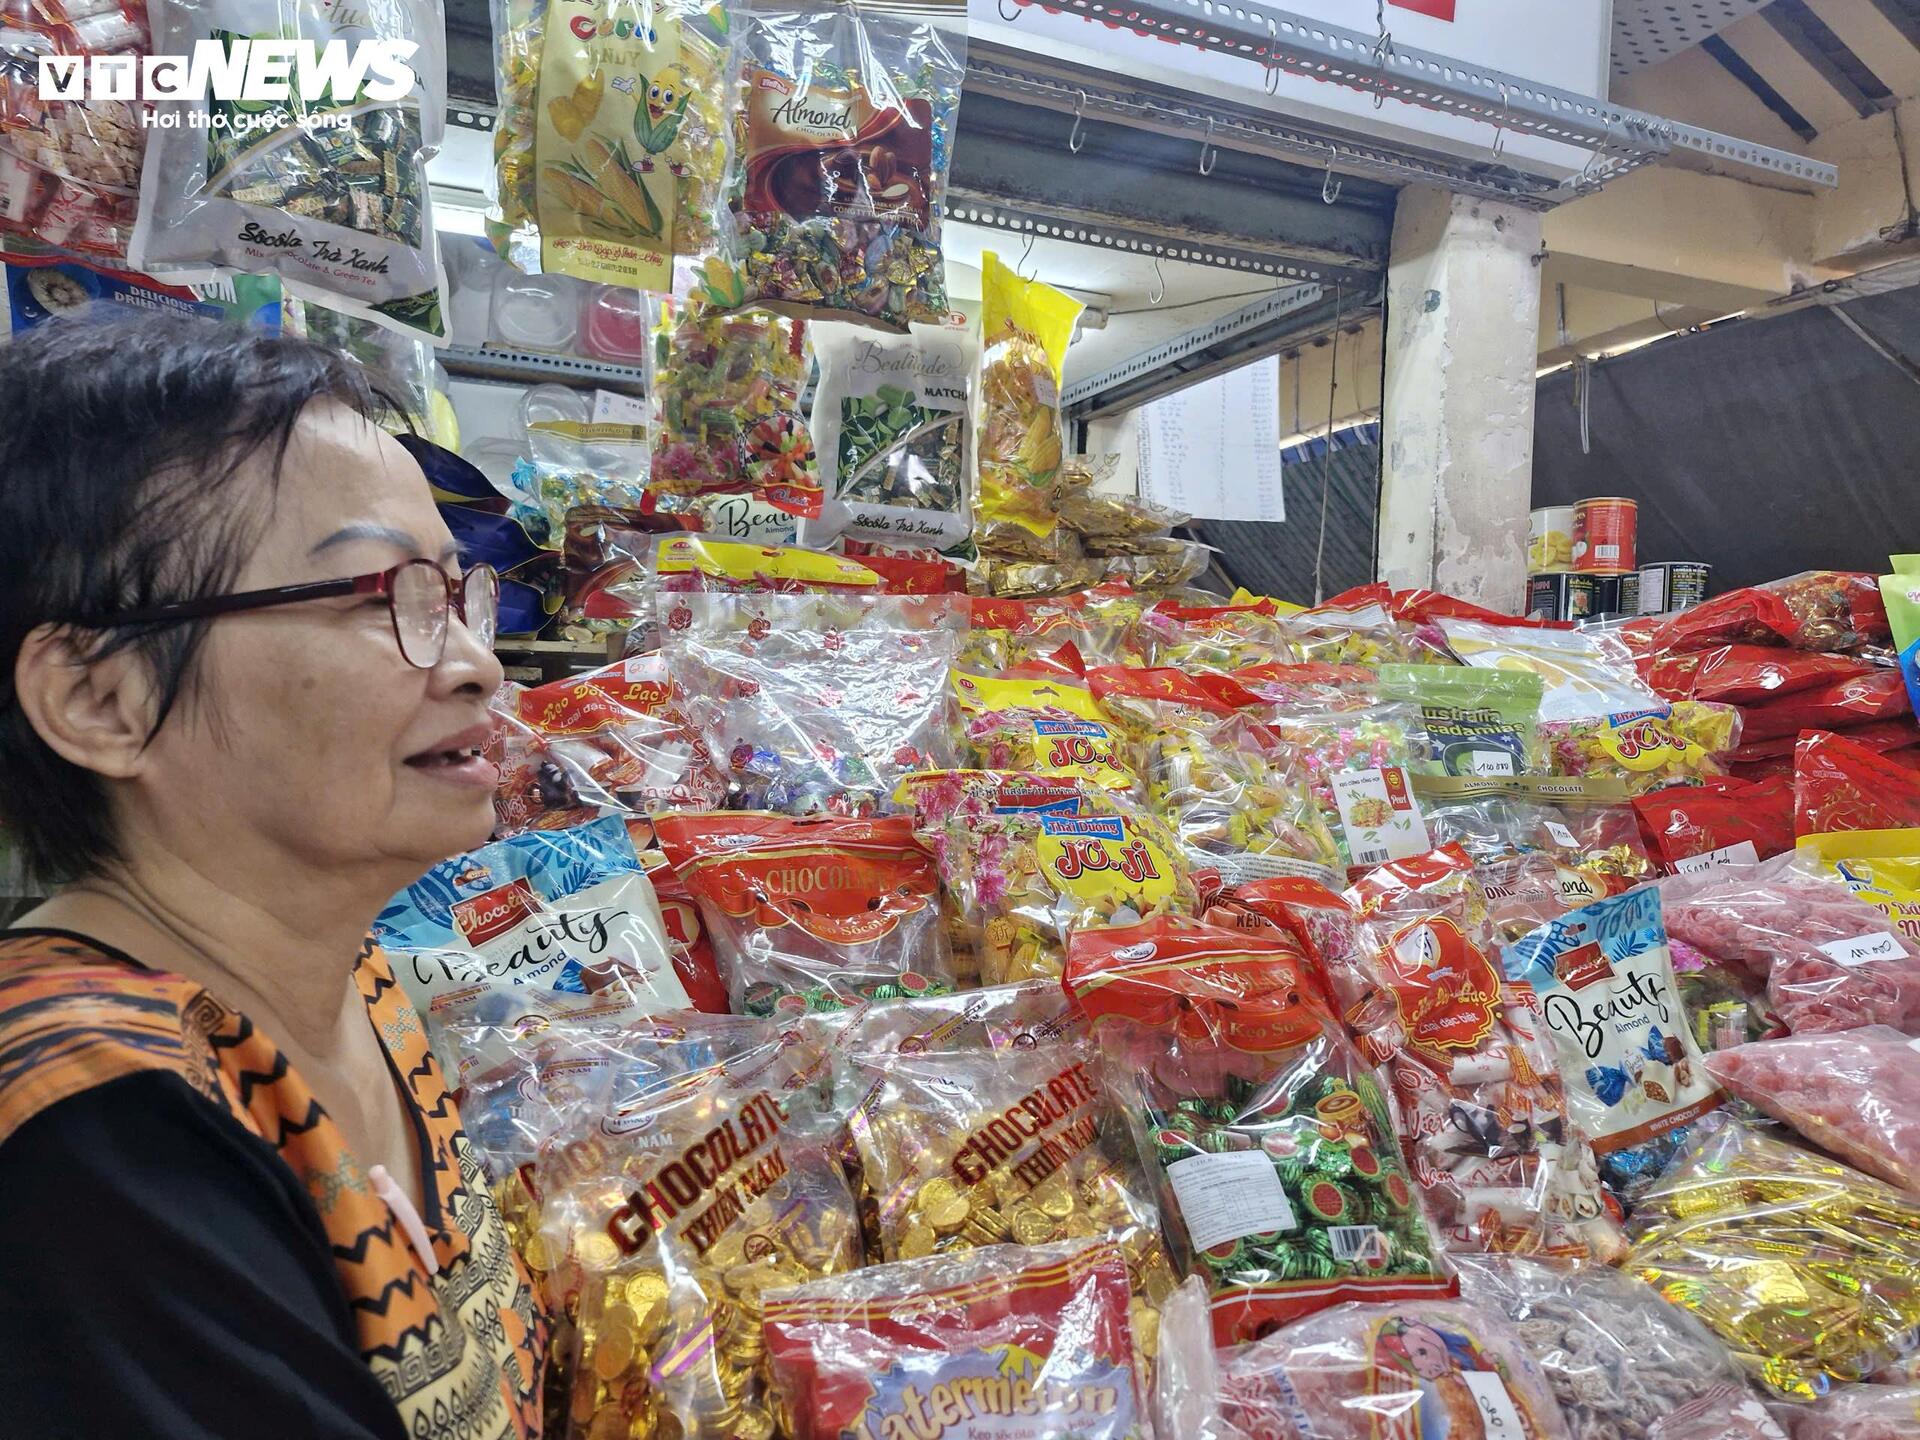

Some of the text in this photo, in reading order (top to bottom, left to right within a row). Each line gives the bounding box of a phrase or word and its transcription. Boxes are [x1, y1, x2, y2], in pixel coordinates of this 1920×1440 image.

[770, 97, 852, 130] Almond
[238, 223, 390, 273] Sôcôla Trà Xanh
[287, 250, 321, 271] ocolate
[333, 268, 360, 281] Green
[114, 291, 158, 310] DRIED
[130, 285, 195, 313] DELICIOUS
[718, 498, 798, 537] Beau
[896, 518, 914, 532] Trà
[915, 521, 944, 536] Xanh
[765, 525, 795, 534] Almond
[623, 683, 659, 704] Lạc
[1423, 705, 1501, 721] ustralia
[1426, 722, 1526, 737] cadamias
[1464, 781, 1584, 793] ALMOND CHOCOLATE
[1049, 821, 1076, 834] Thái
[1562, 876, 1593, 894] ond
[413, 907, 629, 985] Beauty
[513, 950, 567, 987] Amond
[1544, 971, 1669, 1059] Beauty
[1615, 1015, 1650, 1035] Almond
[952, 1062, 1099, 1186] CHOCOLATE
[1650, 1118, 1669, 1132] WHITE
[638, 1133, 673, 1147] NAM
[608, 1089, 790, 1257] CHOCOLATE
[739, 1143, 788, 1203] NAM
